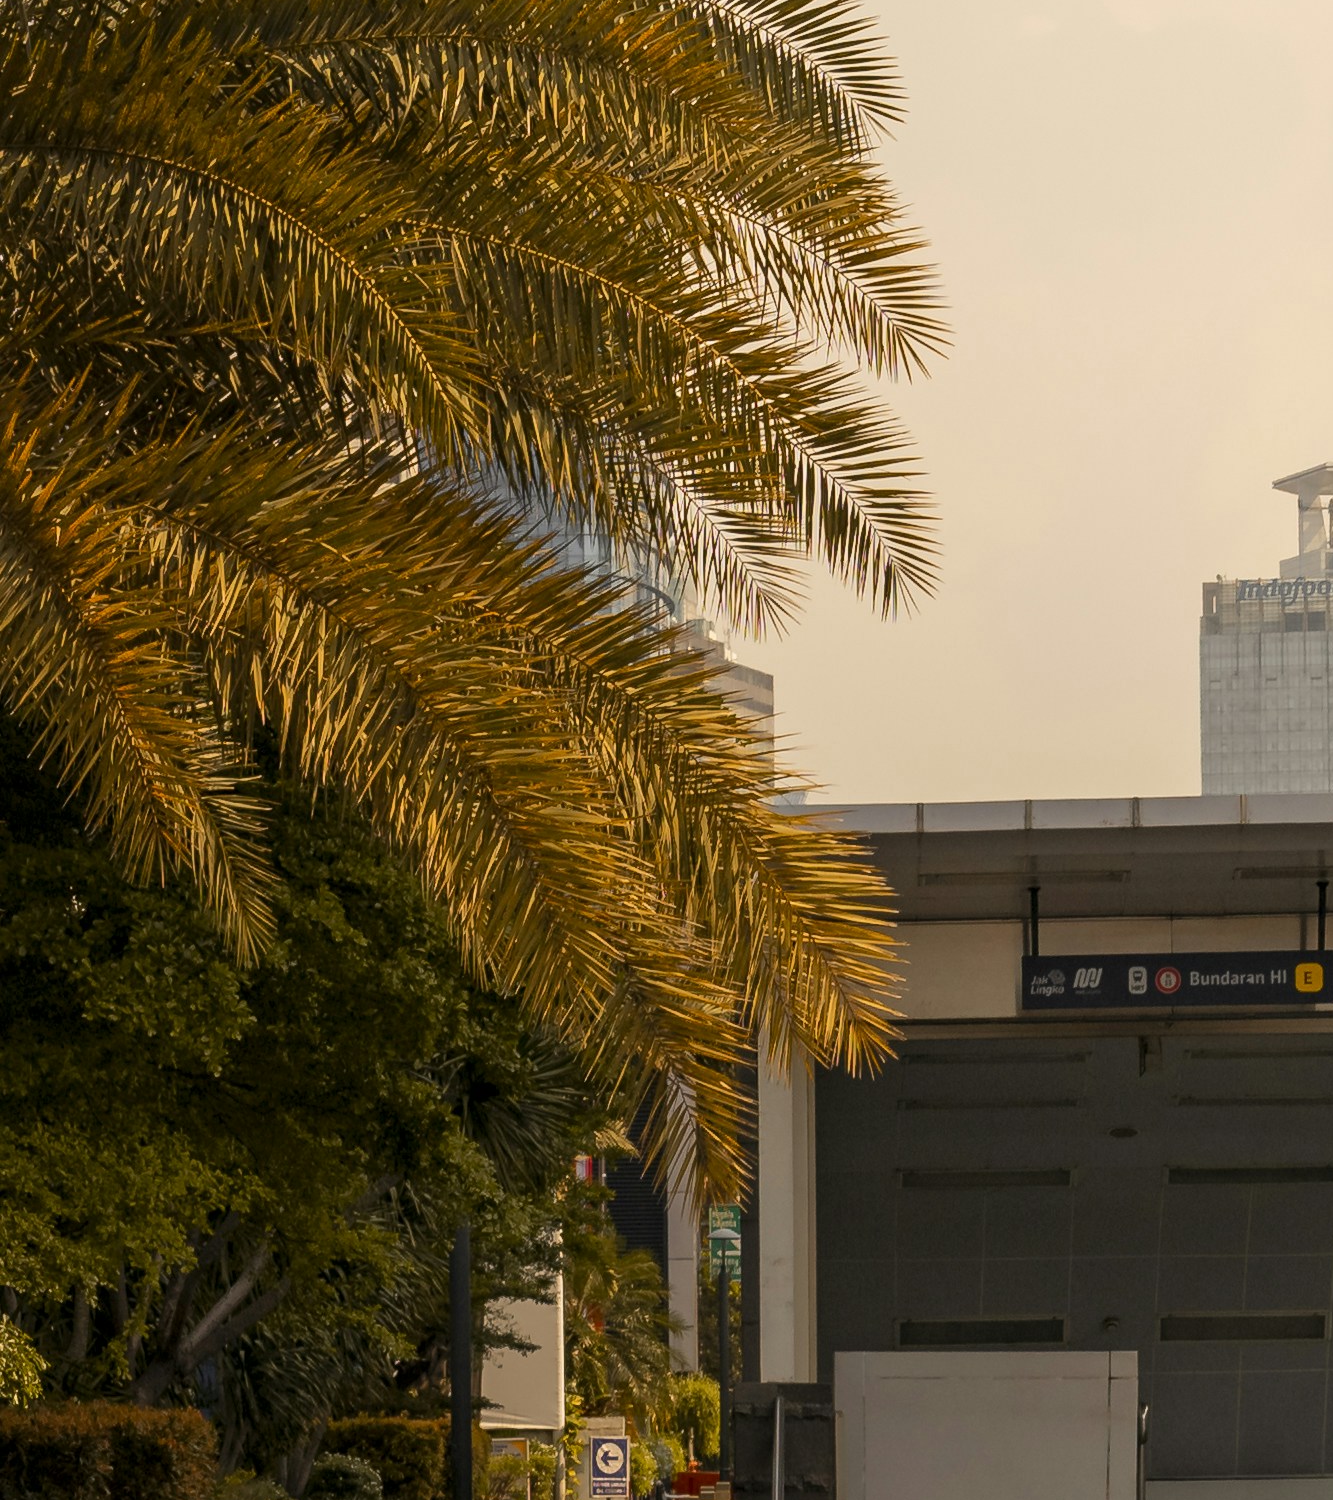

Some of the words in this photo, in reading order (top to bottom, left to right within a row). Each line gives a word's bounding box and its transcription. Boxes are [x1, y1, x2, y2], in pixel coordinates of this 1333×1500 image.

[1190, 970, 1265, 986] Bundaran
[1270, 969, 1287, 984] HI
[1304, 971, 1313, 985] E
[1030, 985, 1065, 997] Lingko
